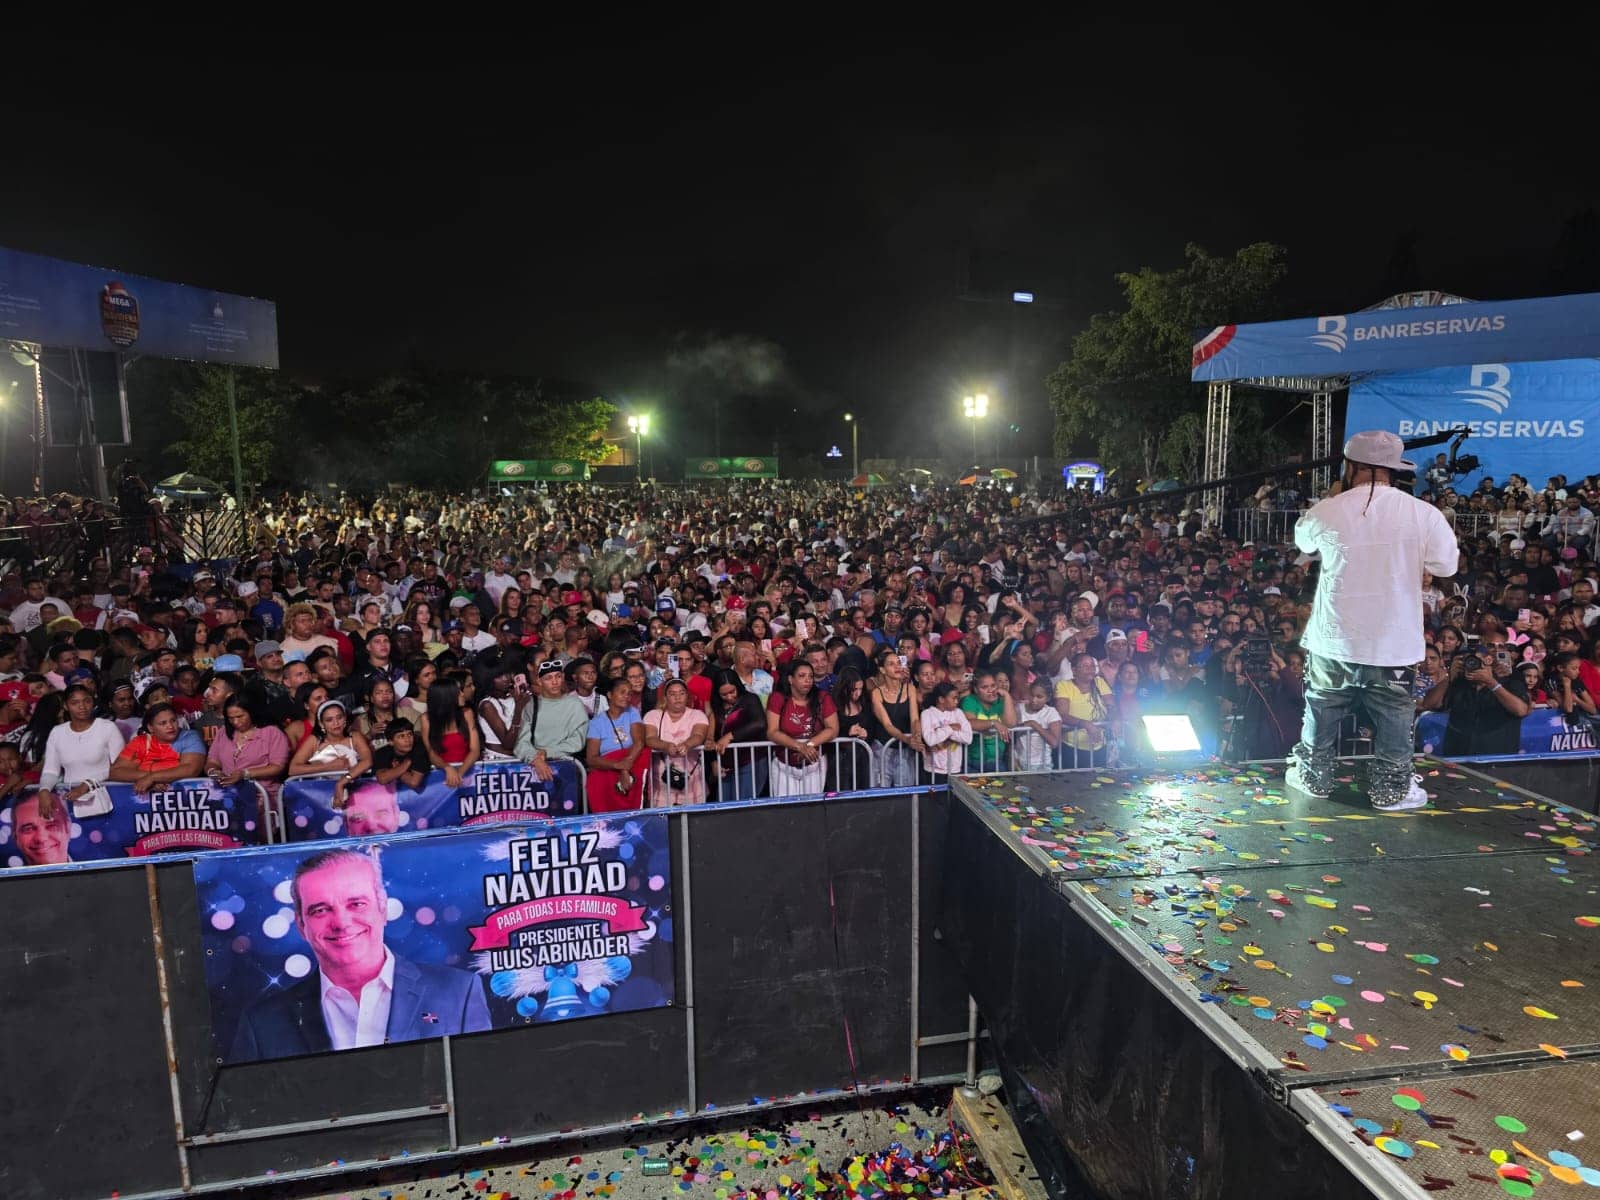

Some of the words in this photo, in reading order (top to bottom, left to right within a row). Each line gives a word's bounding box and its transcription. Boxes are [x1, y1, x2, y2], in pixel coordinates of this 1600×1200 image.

[1353, 315, 1505, 341] BANRESERVAS
[476, 773, 532, 795] FELIZ
[151, 790, 210, 812] FELIZ
[460, 792, 549, 817] NAVIDAD
[135, 810, 229, 833] NAVIDAD
[143, 837, 160, 850] PARA
[160, 833, 181, 845] TODAS
[181, 832, 194, 843] LAS
[194, 832, 224, 847] FAMILIAS
[511, 833, 600, 872] FELIZ
[486, 862, 626, 906] NAVIDAD
[497, 910, 522, 930] PARA
[524, 902, 554, 920] TODAS
[556, 900, 573, 914] LAS
[575, 900, 618, 916] FAMILIAS
[519, 923, 601, 947] PRESIDENTE
[493, 948, 533, 971] LUIS
[538, 936, 628, 965] ABINADER
